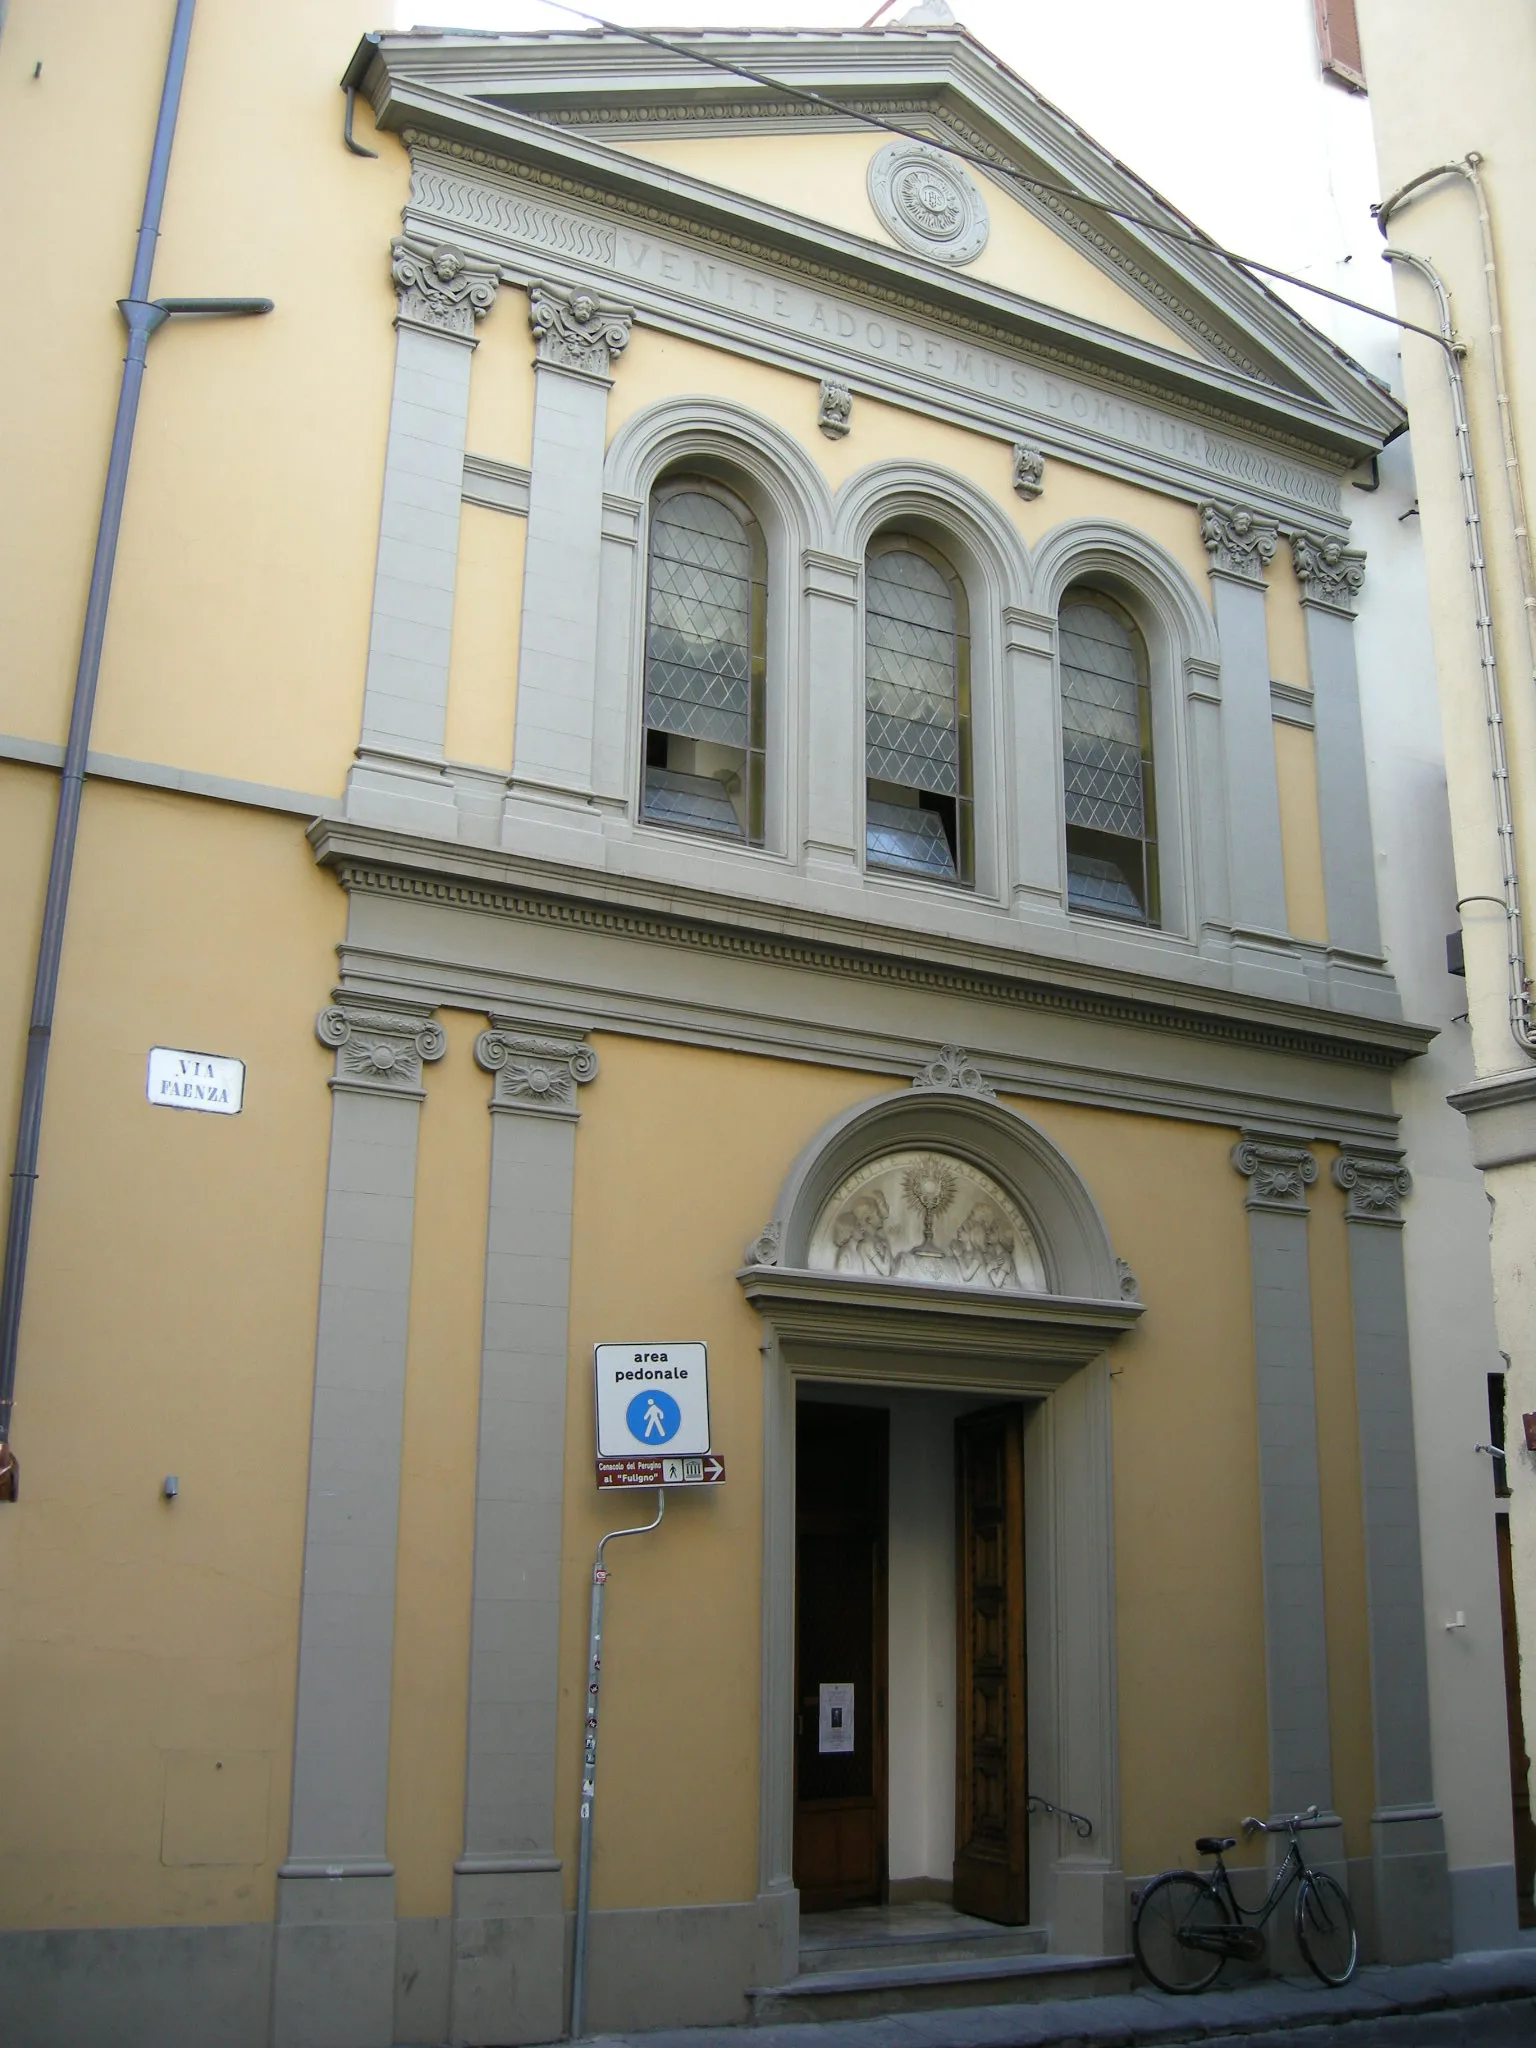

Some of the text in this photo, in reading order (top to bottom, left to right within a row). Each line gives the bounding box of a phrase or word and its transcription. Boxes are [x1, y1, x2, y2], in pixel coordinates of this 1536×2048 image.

[622, 236, 1202, 461] VENITE ADOREMUS DOMINUM
[179, 1060, 214, 1078] VIA
[160, 1080, 229, 1103] FAENZA
[634, 1353, 668, 1362] area
[615, 1367, 688, 1382] pedonale
